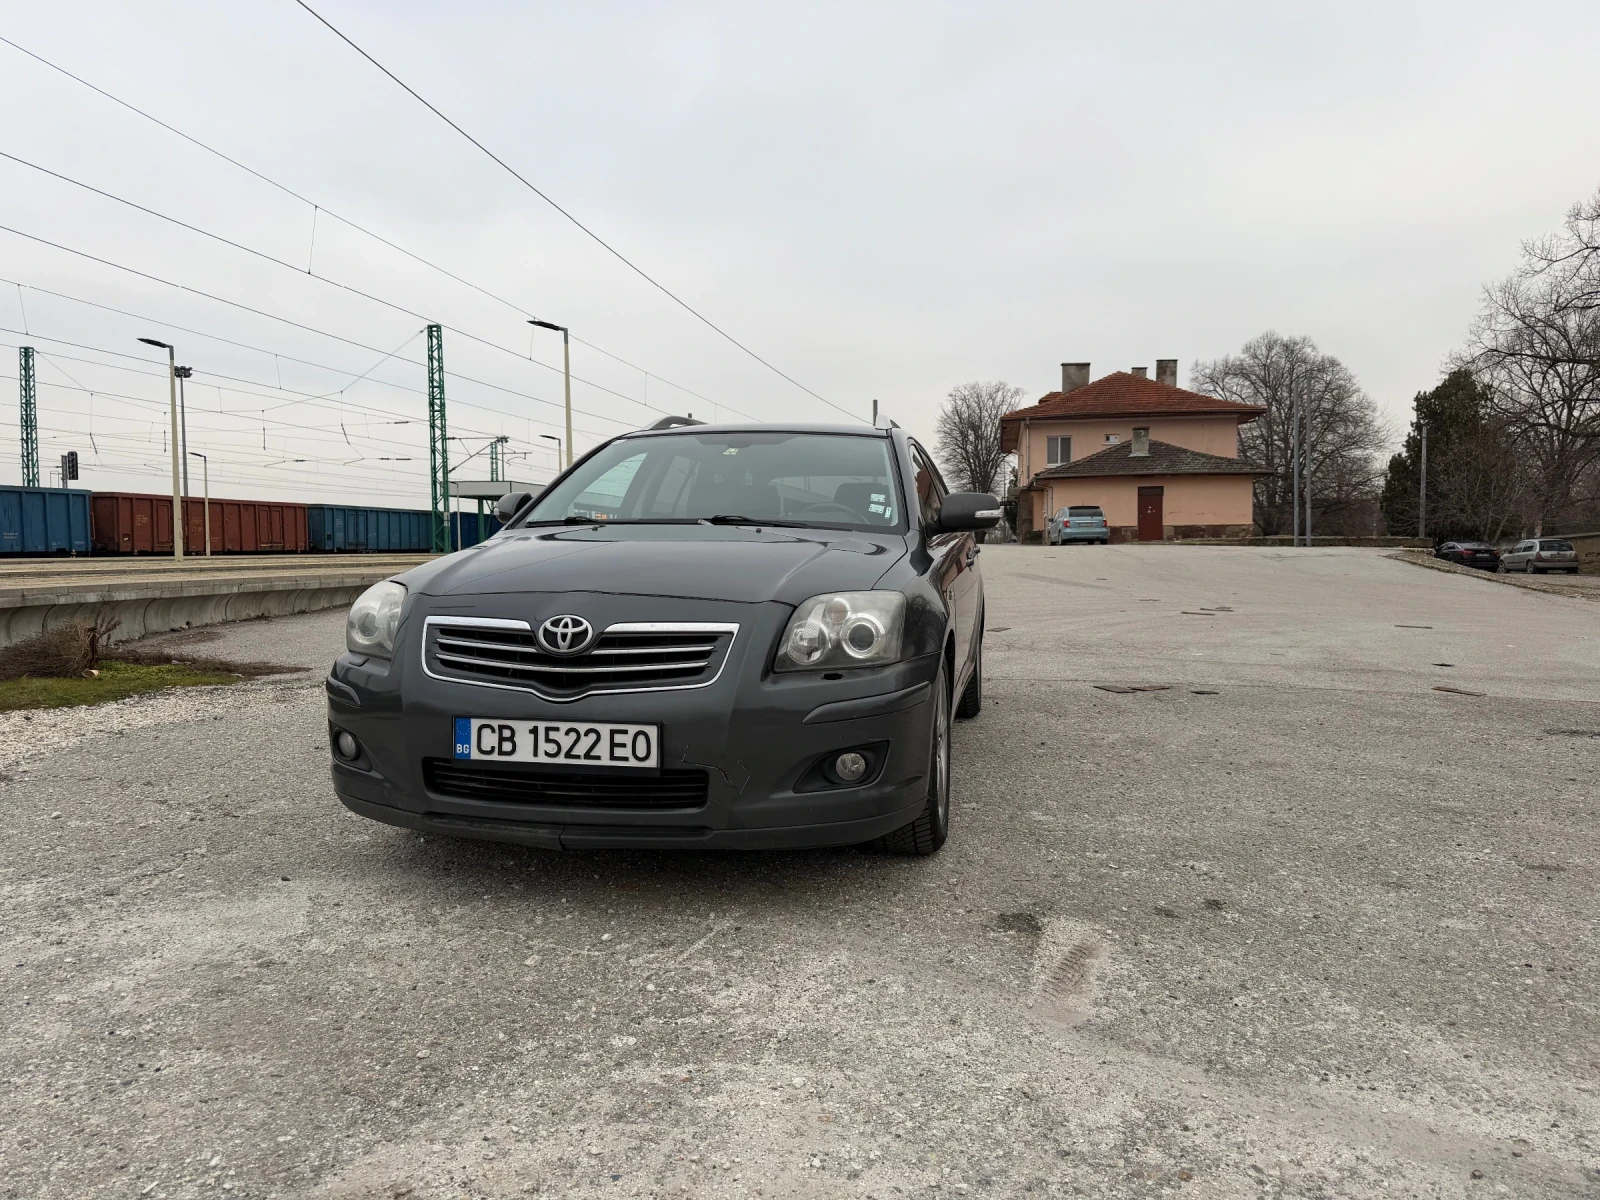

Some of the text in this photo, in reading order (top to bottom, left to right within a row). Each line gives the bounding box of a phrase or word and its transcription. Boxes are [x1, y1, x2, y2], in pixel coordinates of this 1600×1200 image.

[456, 743, 470, 754] BG
[476, 723, 517, 757] CB
[528, 724, 602, 761] 1522
